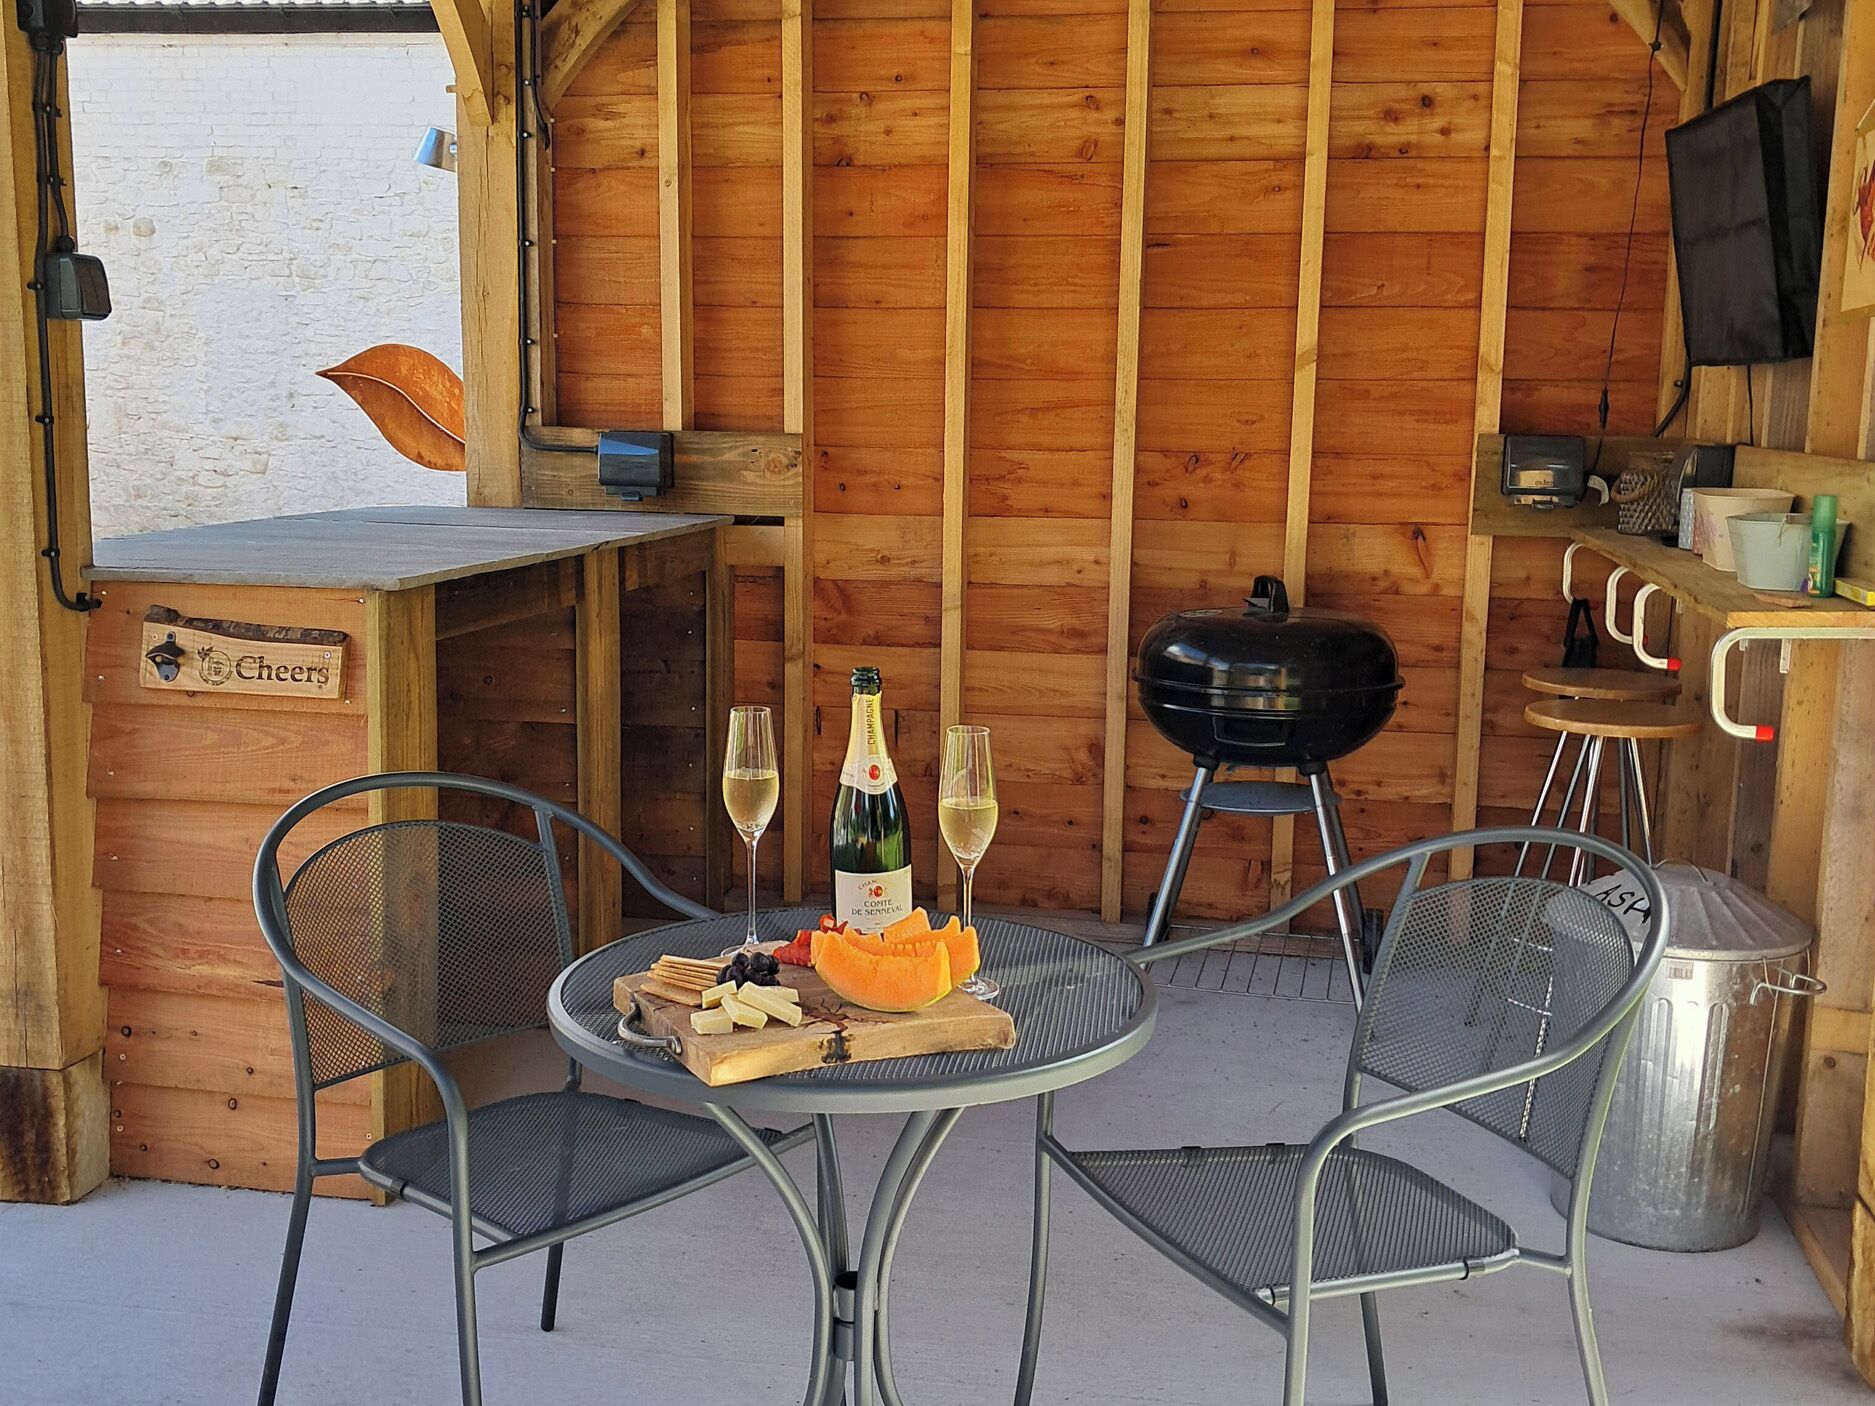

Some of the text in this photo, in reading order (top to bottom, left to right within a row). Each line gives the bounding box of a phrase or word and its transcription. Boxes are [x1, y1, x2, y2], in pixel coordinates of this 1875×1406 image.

[235, 655, 330, 685] Cheers
[865, 698, 876, 745] CHAMPAGNE
[851, 905, 903, 916] DE SENNEVAL
[864, 898, 893, 908] COMTE
[1593, 883, 1652, 925] ASH
